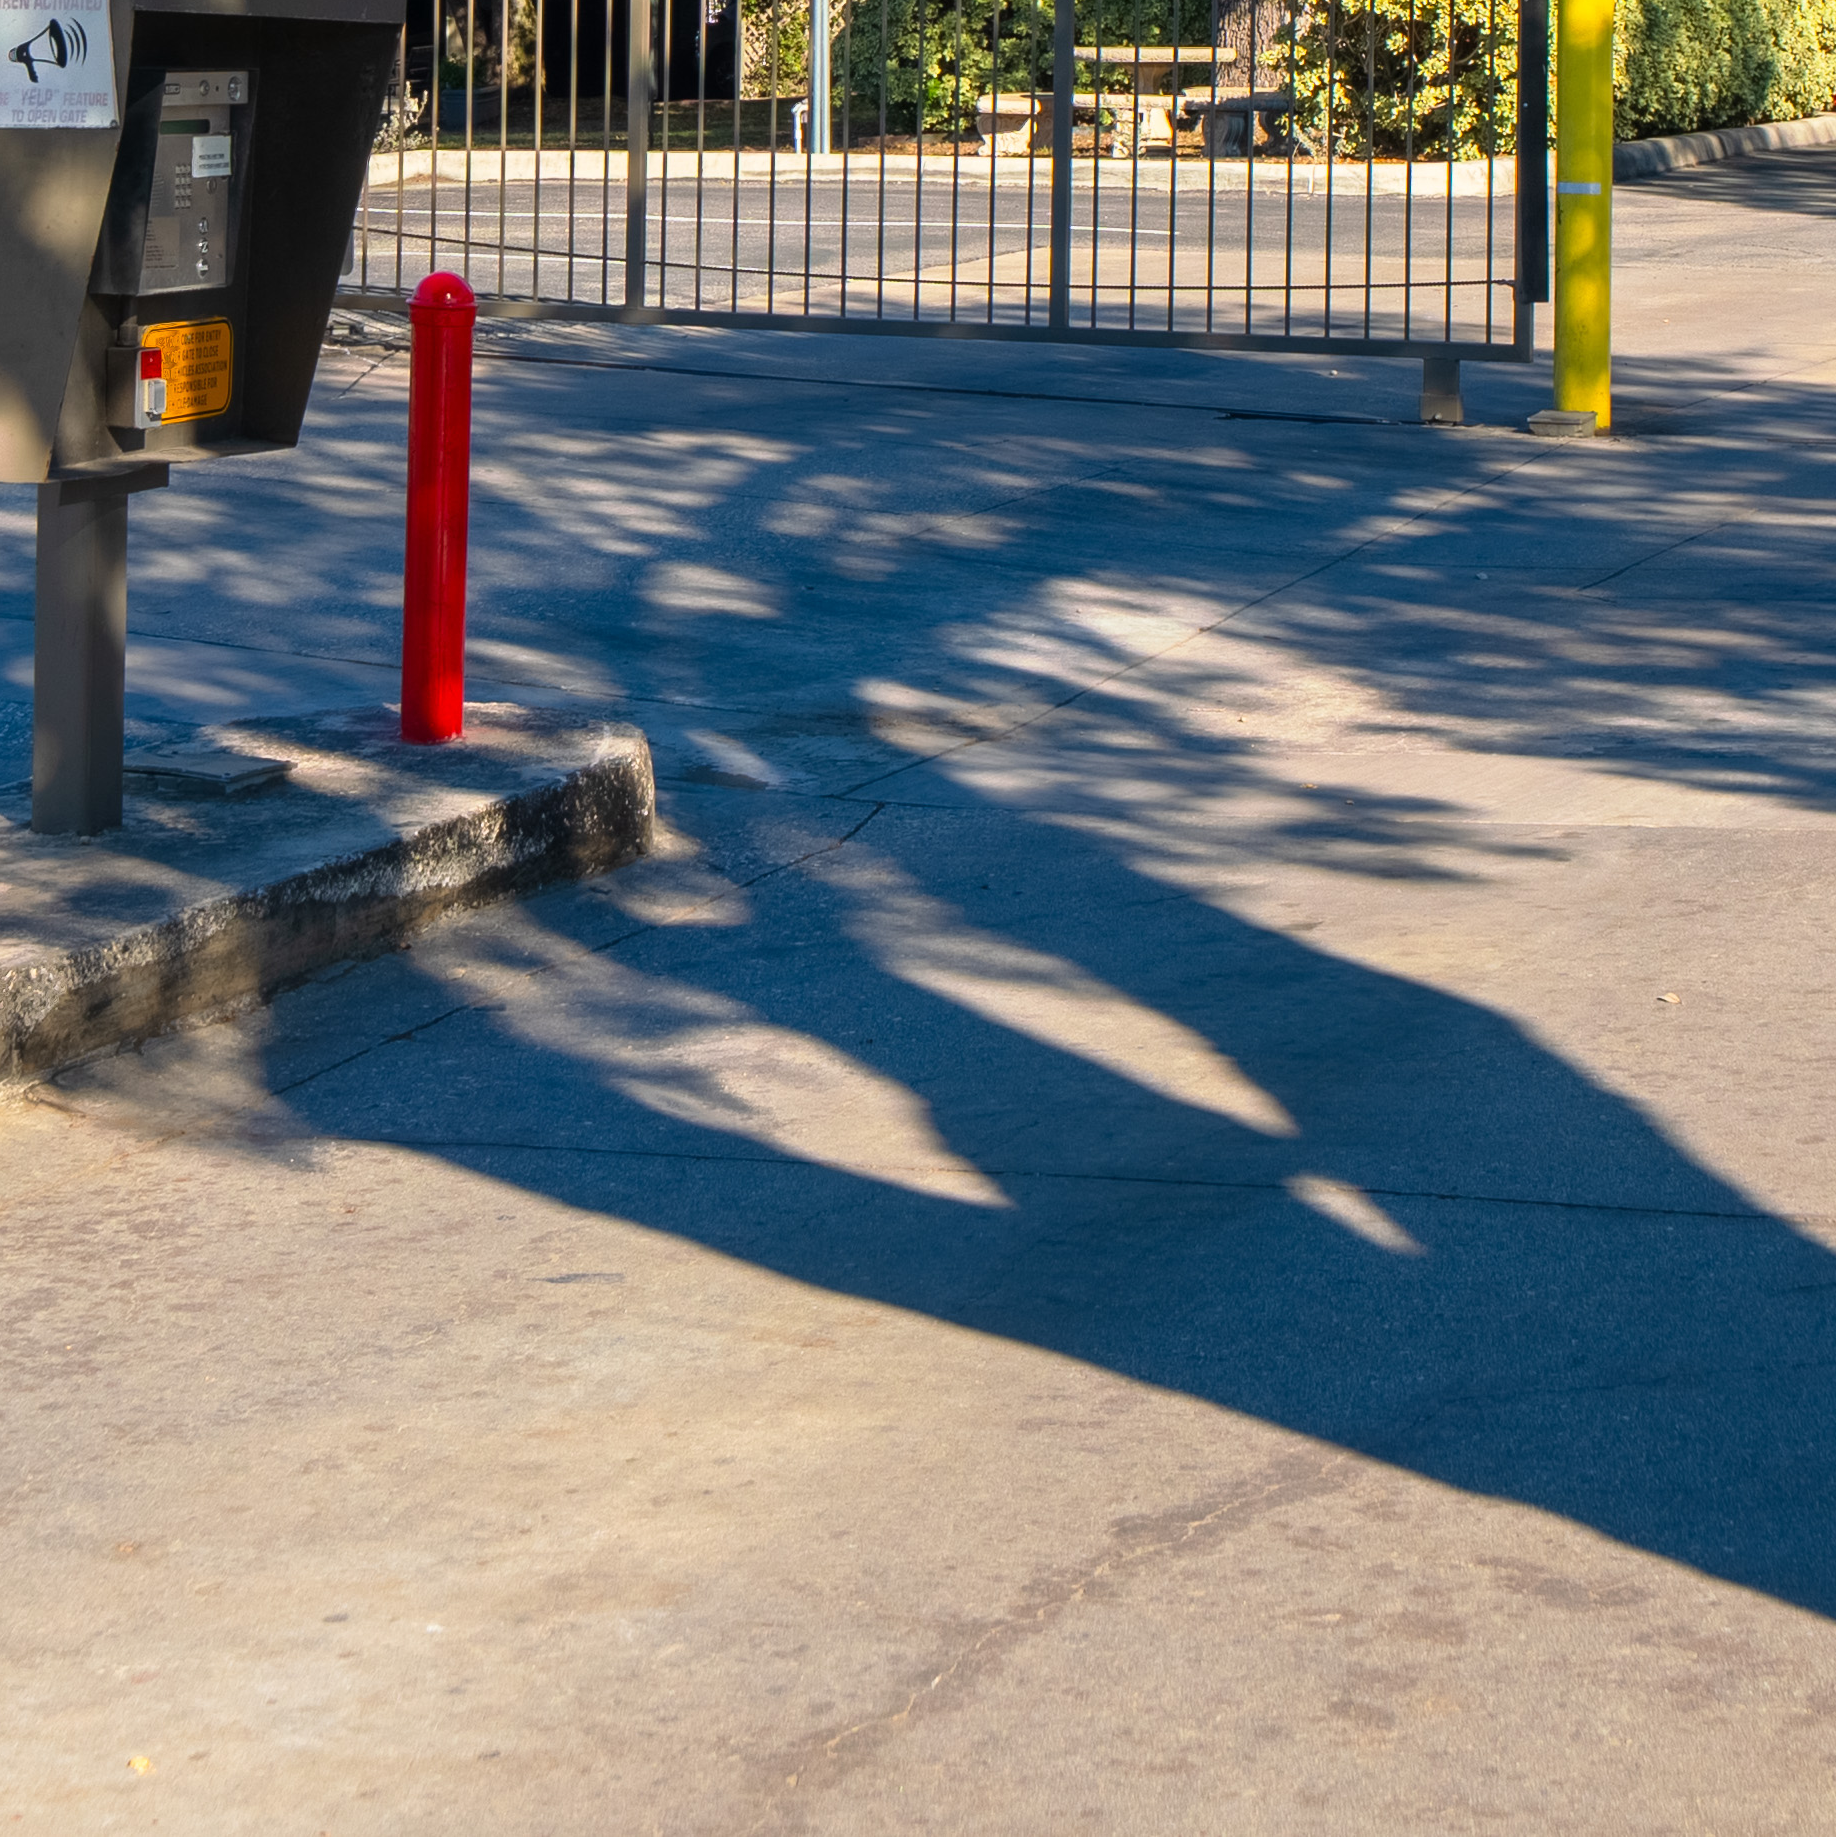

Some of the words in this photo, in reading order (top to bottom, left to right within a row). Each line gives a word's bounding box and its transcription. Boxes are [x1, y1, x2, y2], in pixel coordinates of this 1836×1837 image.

[64, 92, 108, 107] FEATURE
[12, 110, 25, 122] TO
[27, 110, 57, 123] OPEN
[59, 110, 88, 123] GATE
[195, 331, 205, 343] FOR
[205, 329, 222, 342] ENTRY
[203, 345, 219, 358] CLOSE
[195, 360, 228, 374] ASSOCIATION
[208, 376, 218, 389] FOR
